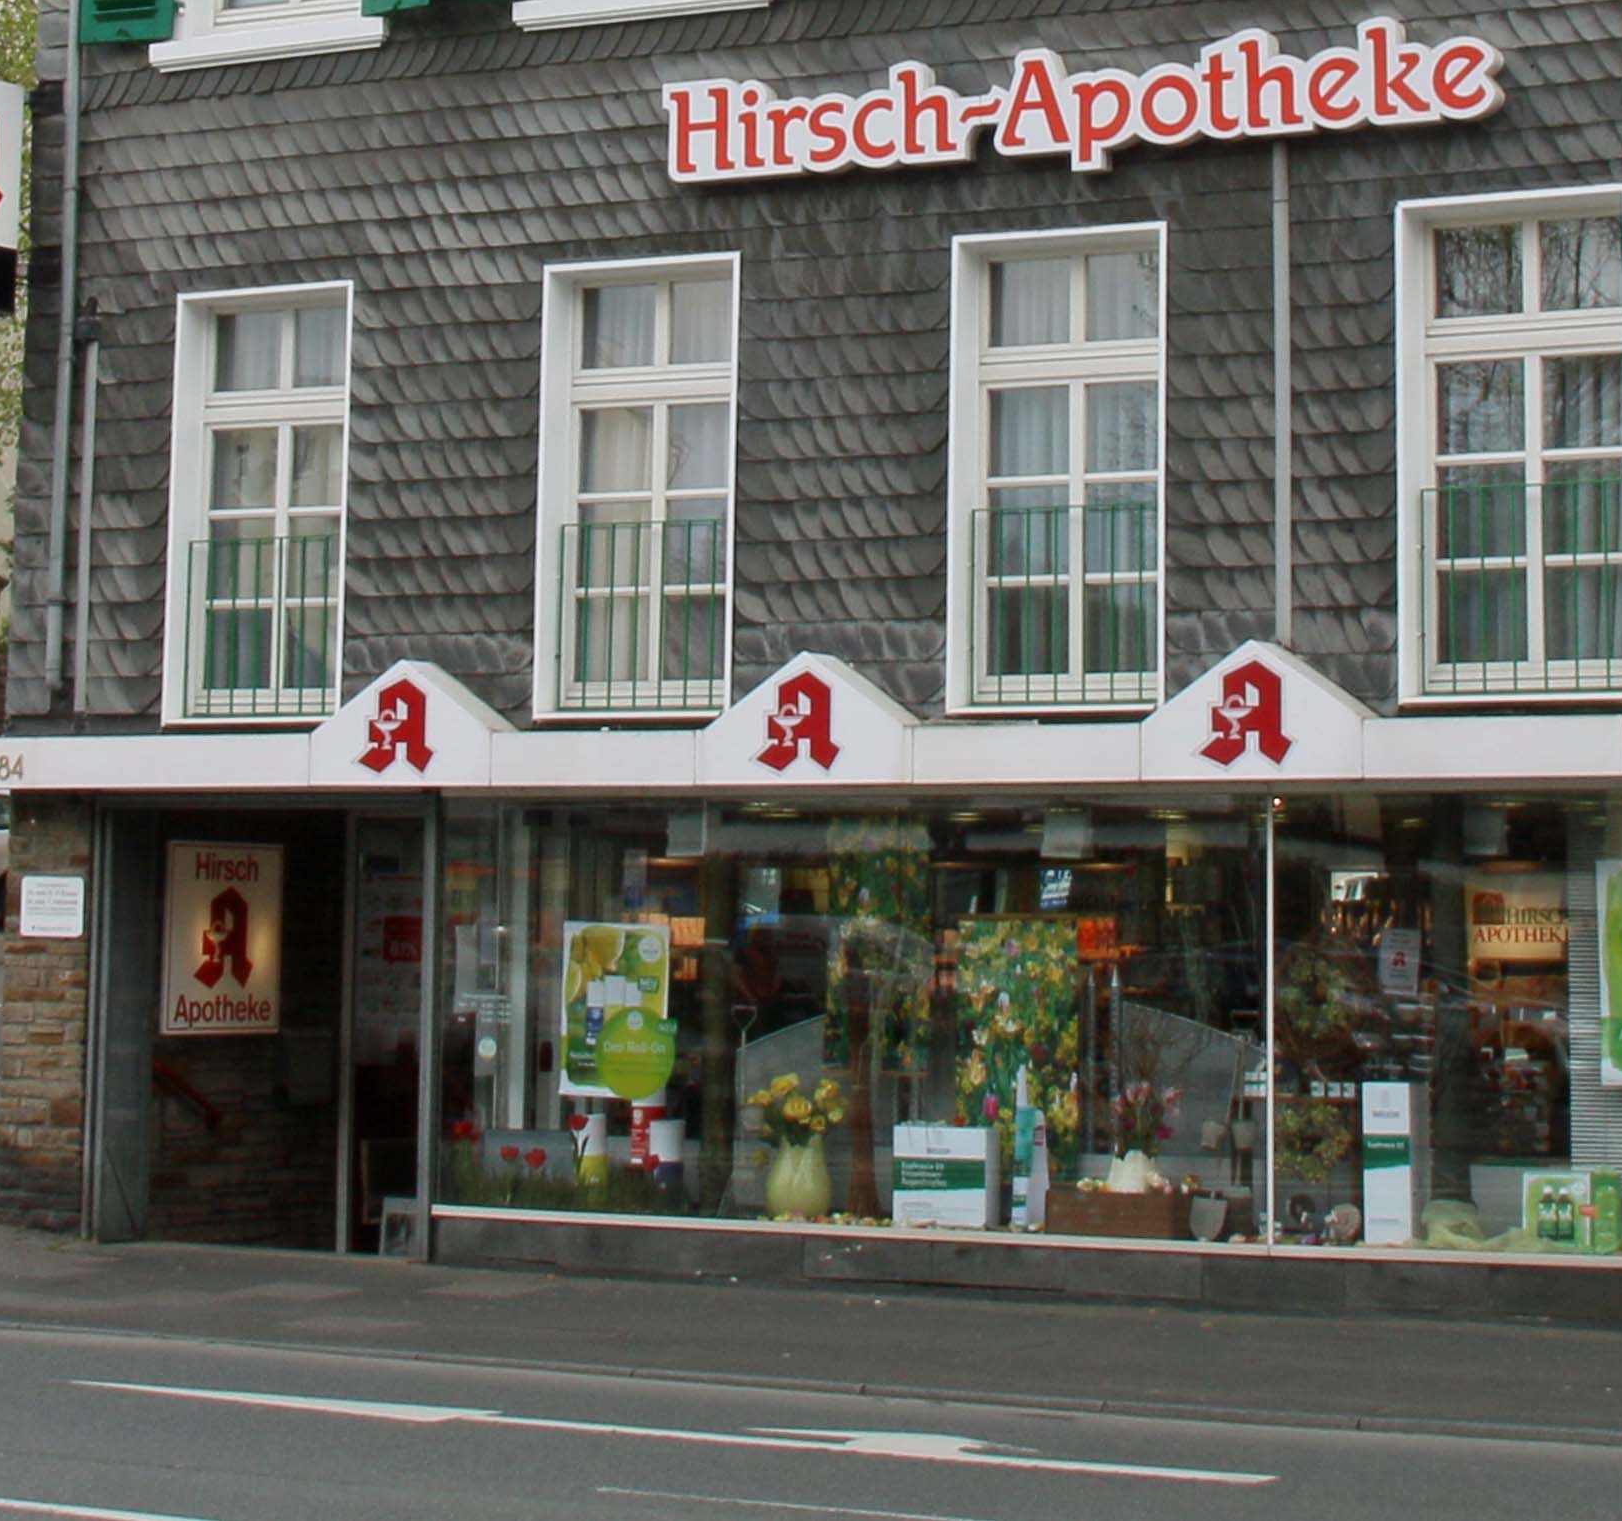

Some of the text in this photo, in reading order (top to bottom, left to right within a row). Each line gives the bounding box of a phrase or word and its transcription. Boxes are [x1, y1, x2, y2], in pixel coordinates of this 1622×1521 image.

[668, 26, 1489, 165] Hirsch-Apotheke
[194, 852, 259, 882] Hirsch
[174, 993, 272, 1028] Apotheke
